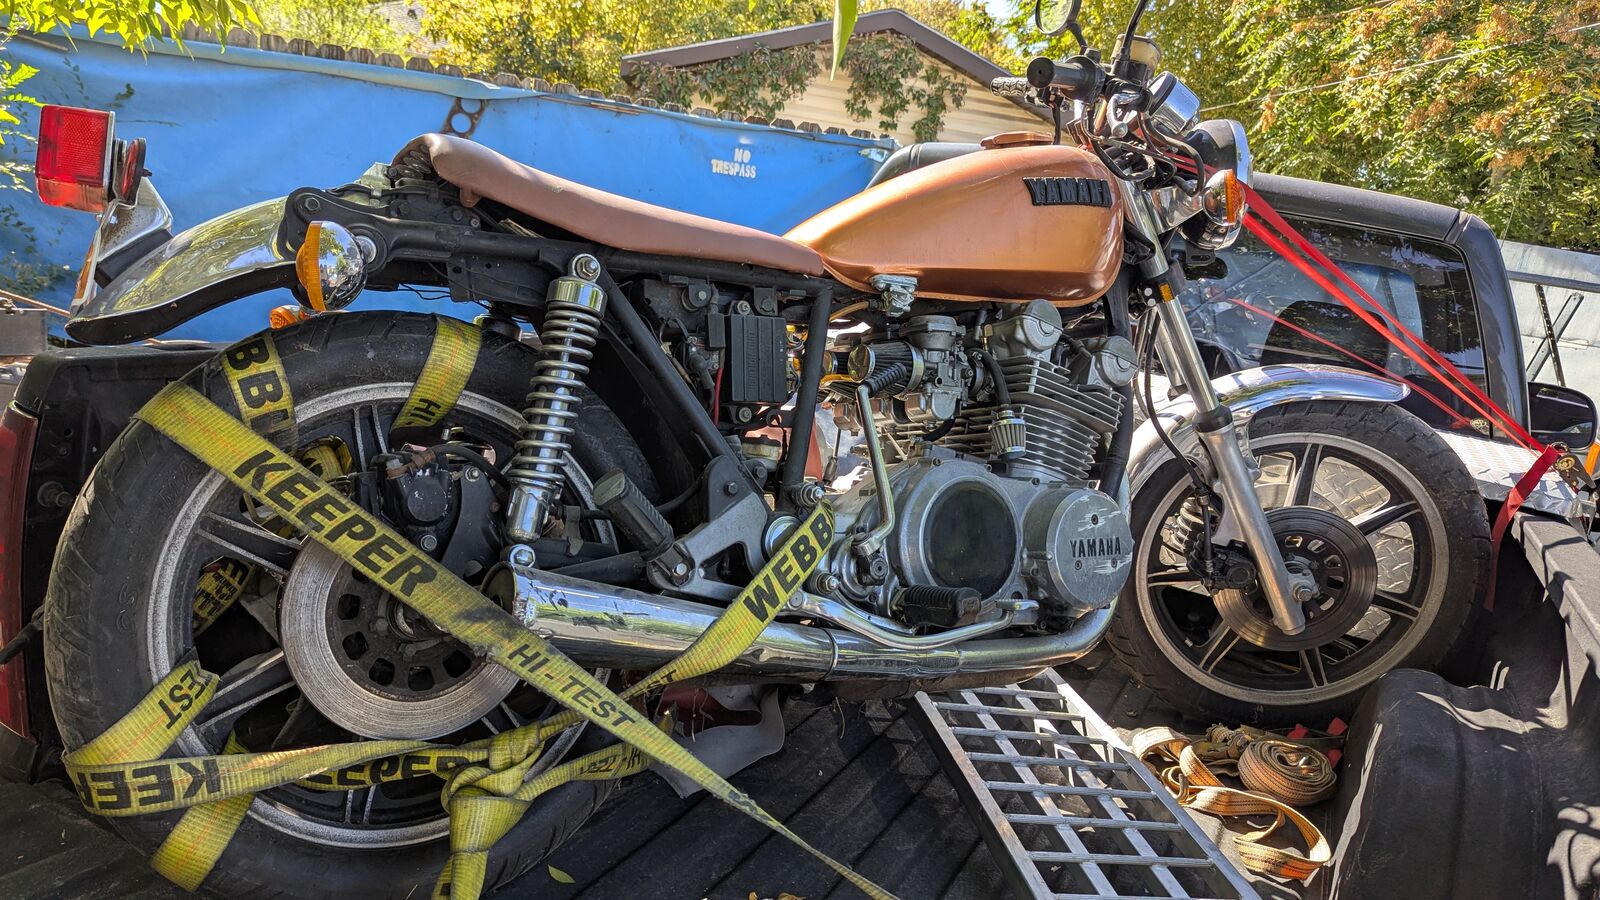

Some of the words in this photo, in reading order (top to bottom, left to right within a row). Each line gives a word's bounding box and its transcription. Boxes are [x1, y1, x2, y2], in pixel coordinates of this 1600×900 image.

[734, 148, 752, 164] NO
[711, 158, 757, 179] TRESPASS
[1069, 536, 1122, 558] YAMAHA
[233, 450, 439, 597] KEEPER
[508, 644, 636, 728] HI-TEST
